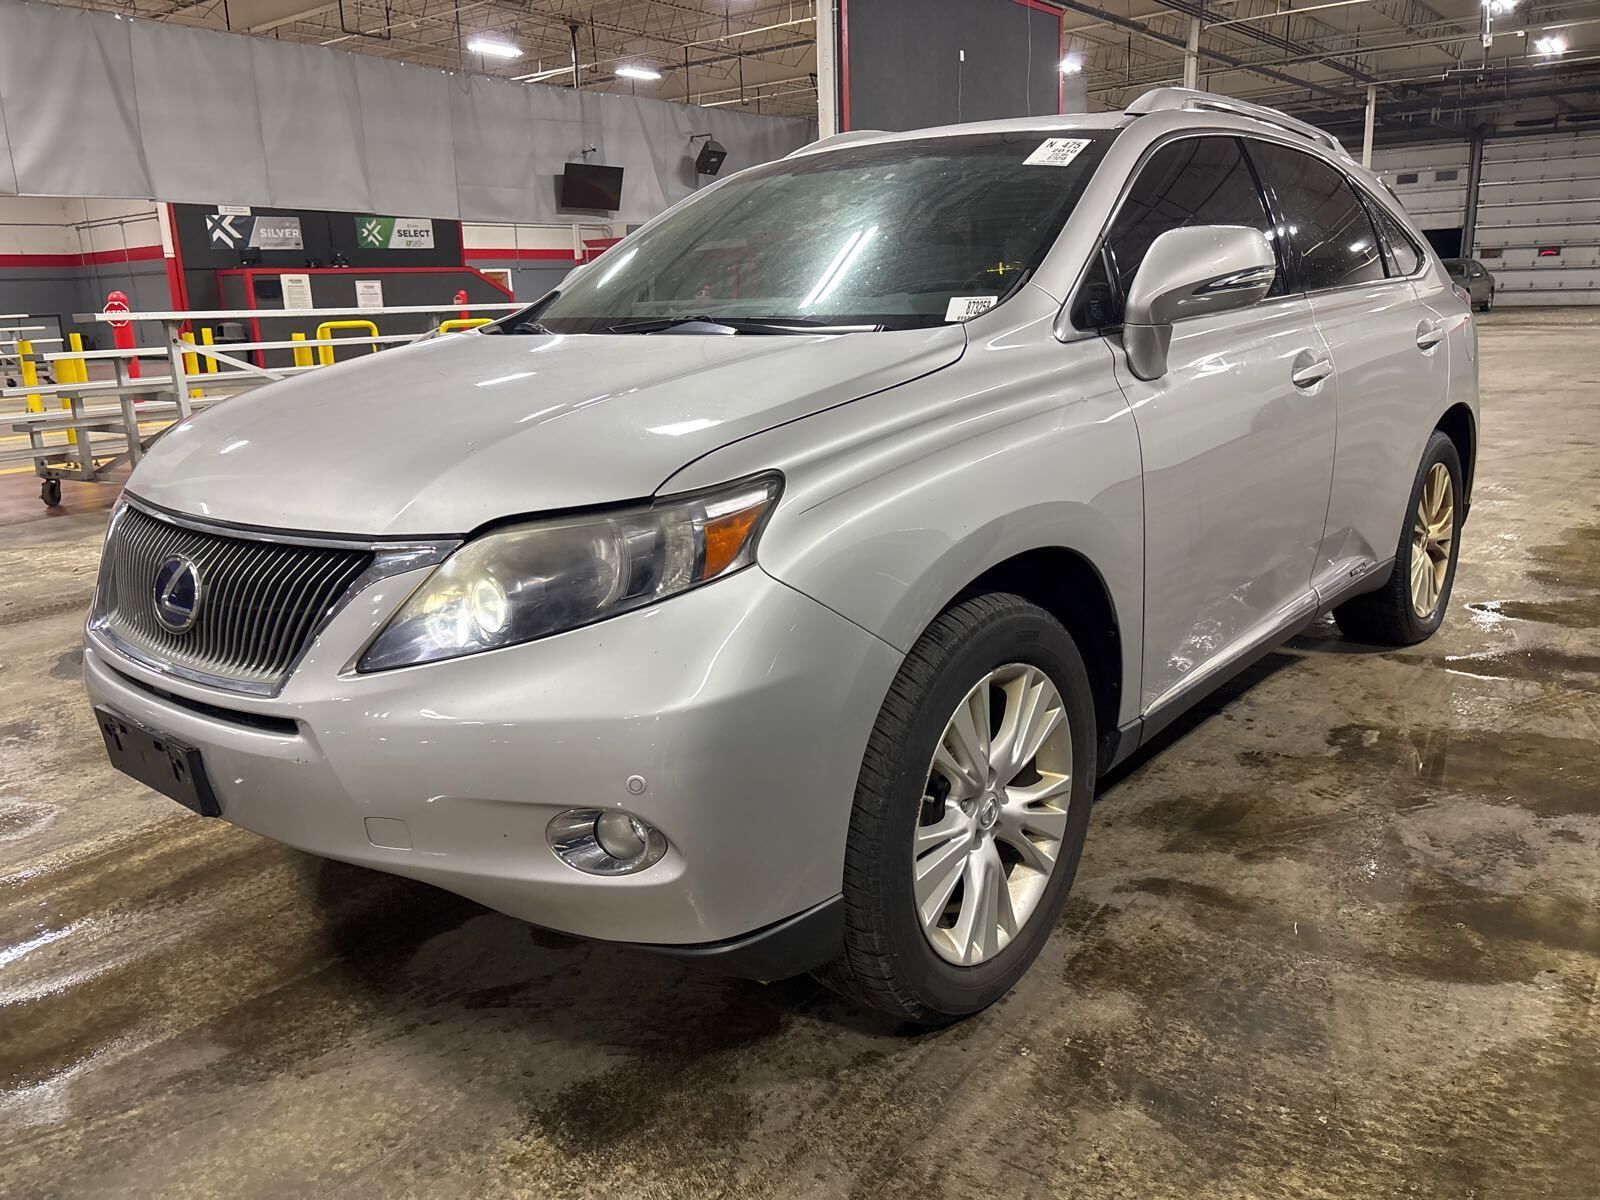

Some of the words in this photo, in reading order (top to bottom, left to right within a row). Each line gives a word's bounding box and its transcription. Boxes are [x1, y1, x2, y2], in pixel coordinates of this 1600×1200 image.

[1062, 141, 1084, 149] 475
[260, 228, 300, 238] SILVER
[397, 229, 430, 238] SELECT
